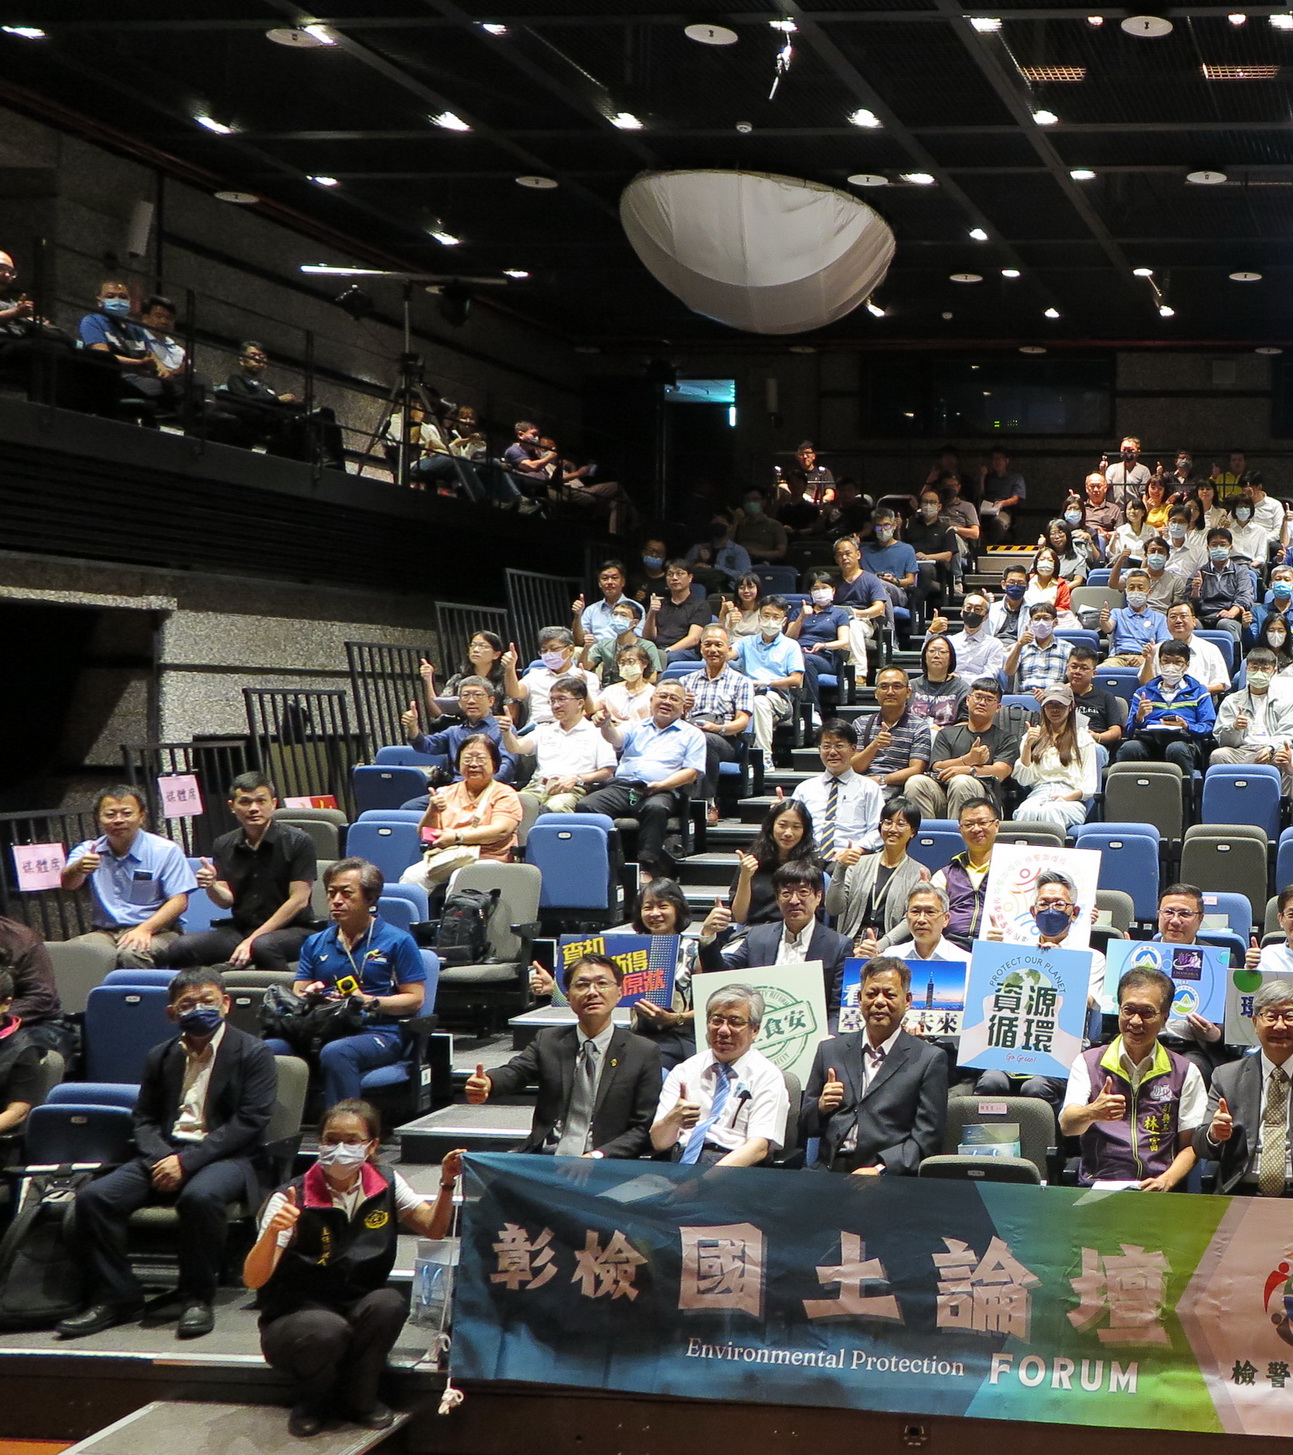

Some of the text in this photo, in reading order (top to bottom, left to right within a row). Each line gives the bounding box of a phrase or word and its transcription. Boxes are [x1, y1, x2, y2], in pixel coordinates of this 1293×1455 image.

[989, 956, 1067, 994] PROTECT OUR PLANET
[992, 982, 1058, 1018] 資源
[987, 1014, 1055, 1053] 循環
[490, 1221, 1175, 1349] 彰檢國土論壇
[685, 1337, 1139, 1394] Environmental Protection FORUM
